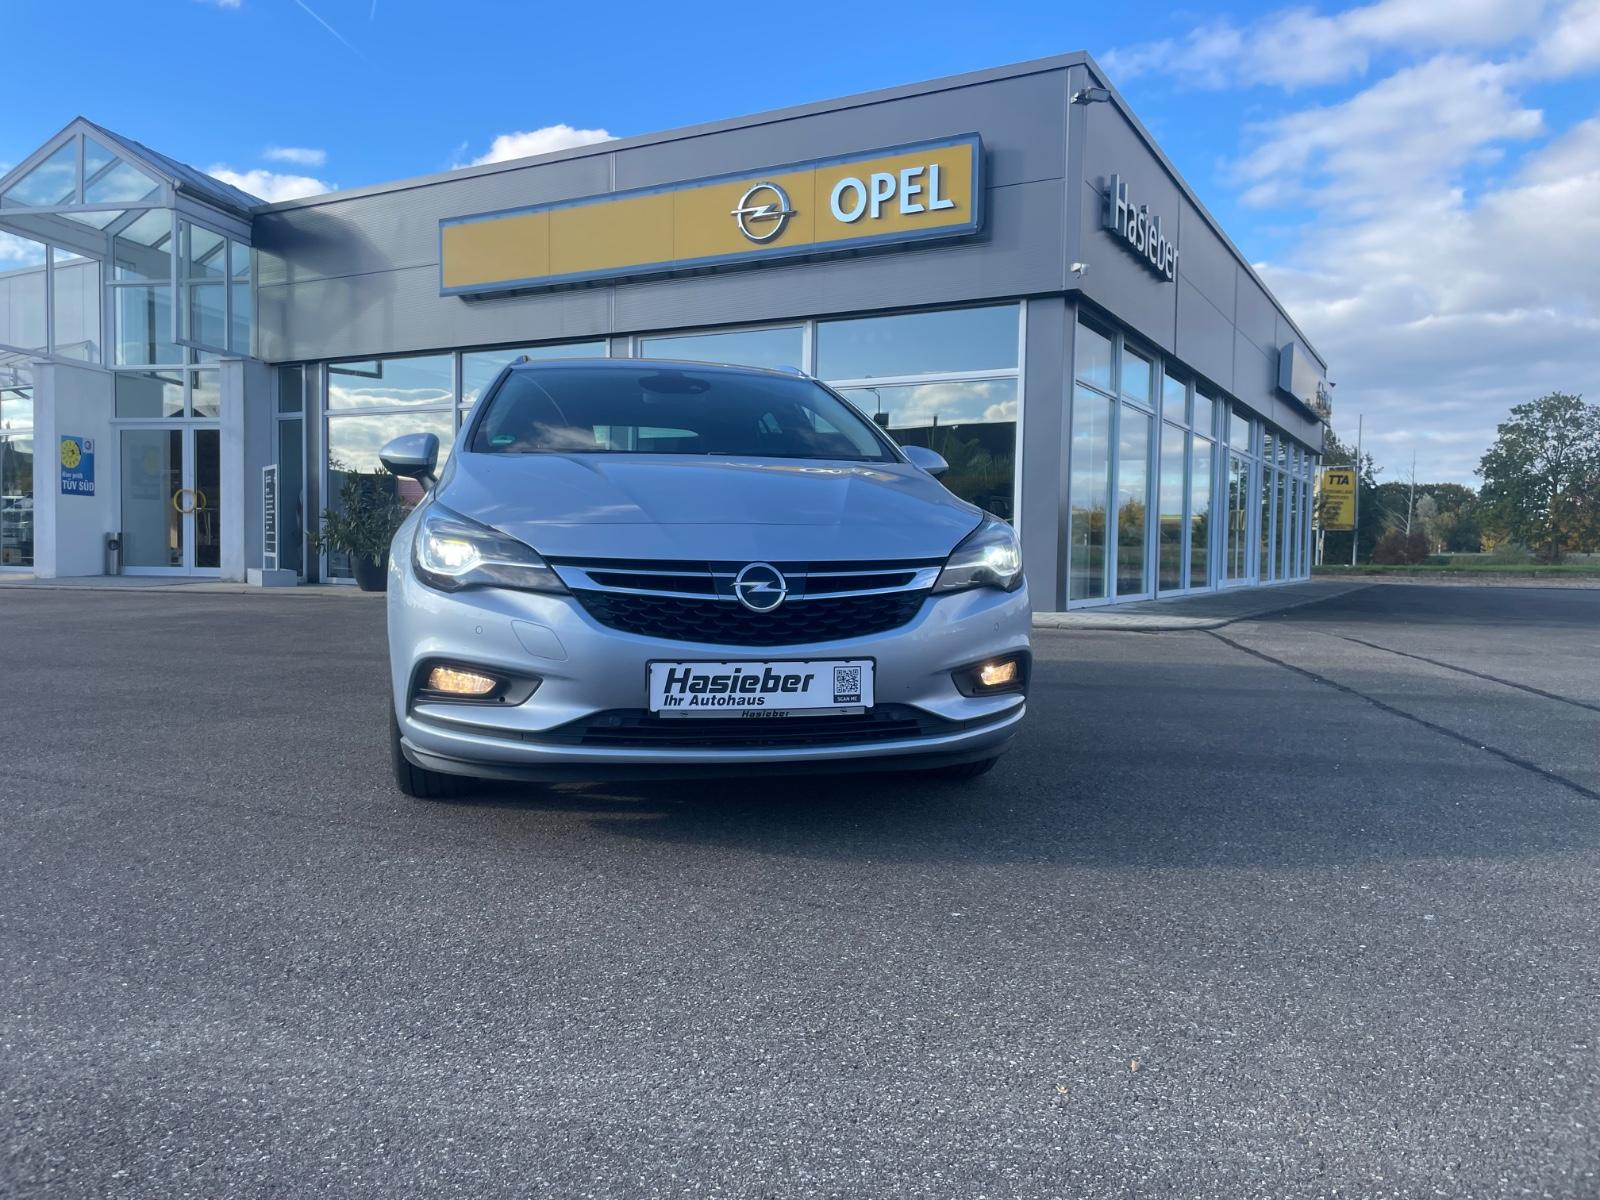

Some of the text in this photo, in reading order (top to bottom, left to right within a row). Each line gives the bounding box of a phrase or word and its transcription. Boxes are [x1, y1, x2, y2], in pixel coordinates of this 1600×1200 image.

[830, 163, 954, 223] OPEL
[1111, 173, 1180, 282] Hasieber
[62, 478, 95, 492] TÜV SÜD
[1328, 474, 1350, 486] TTA
[663, 667, 815, 694] Hasieber
[663, 693, 766, 706] Ihr Autohaus
[741, 709, 791, 718] Hasieber
